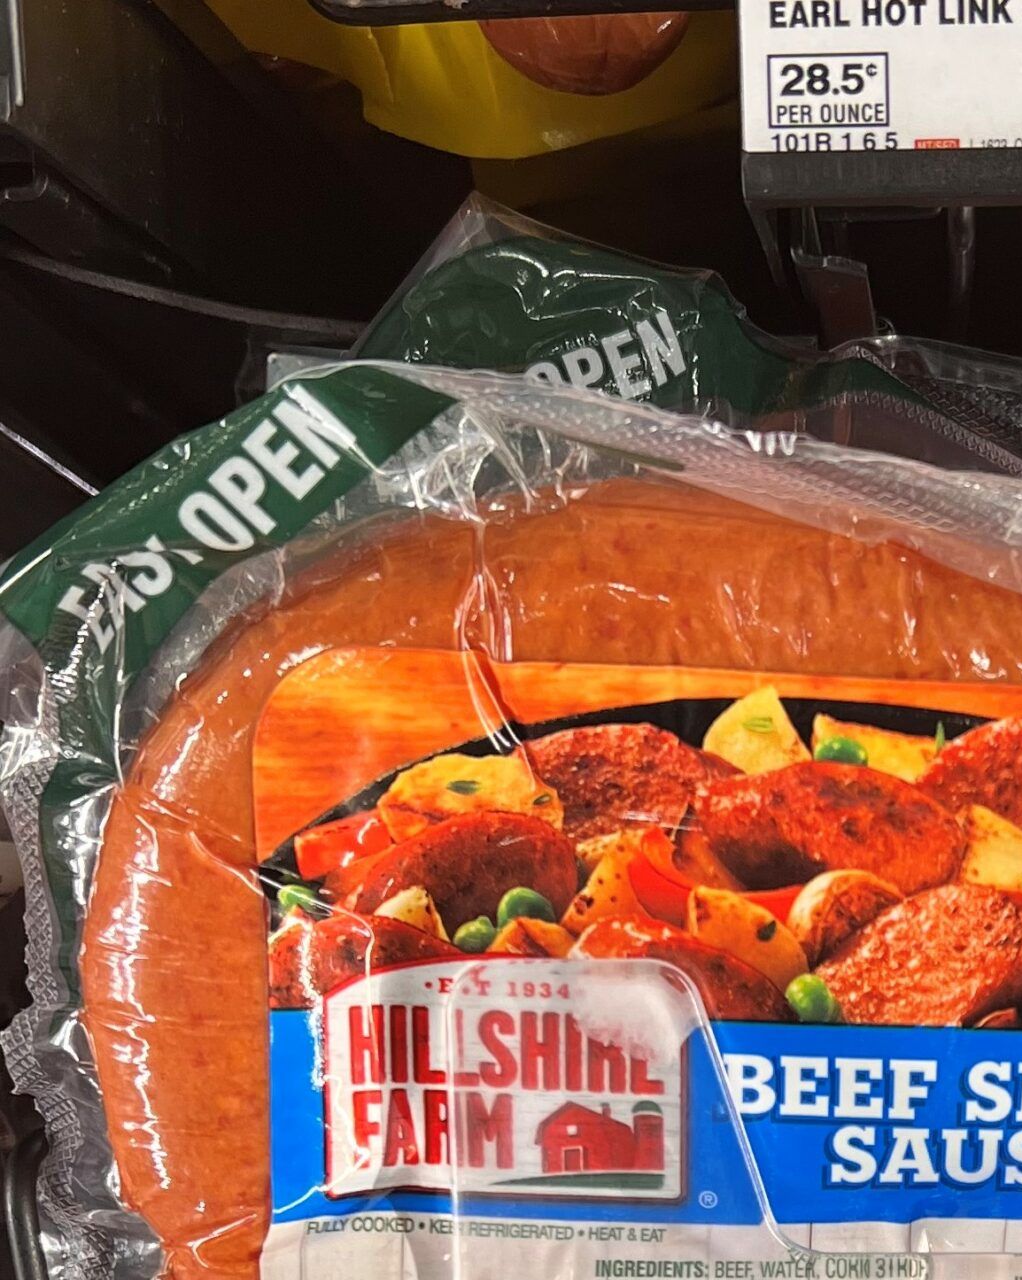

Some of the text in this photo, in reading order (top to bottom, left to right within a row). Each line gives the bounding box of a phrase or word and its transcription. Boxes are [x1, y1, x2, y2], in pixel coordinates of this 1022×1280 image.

[769, 0, 850, 28] EARL
[862, 0, 926, 26] HOT
[939, 0, 1013, 25] LINK
[777, 103, 884, 124] PER OUNCE
[771, 133, 832, 151] 101R
[179, 384, 356, 551] OPEN
[507, 981, 570, 999] 1934
[723, 1053, 937, 1118] BEEF
[352, 1088, 514, 1169] FARM
[307, 1219, 349, 1235] FULLY
[352, 1217, 415, 1234] COOKED
[470, 1223, 574, 1241] REFRIGERATED
[588, 1228, 622, 1242] HEAT
[641, 1229, 666, 1243] EAT
[595, 1259, 709, 1278] INGREDIENTS:
[715, 1261, 754, 1280] BEEF,
